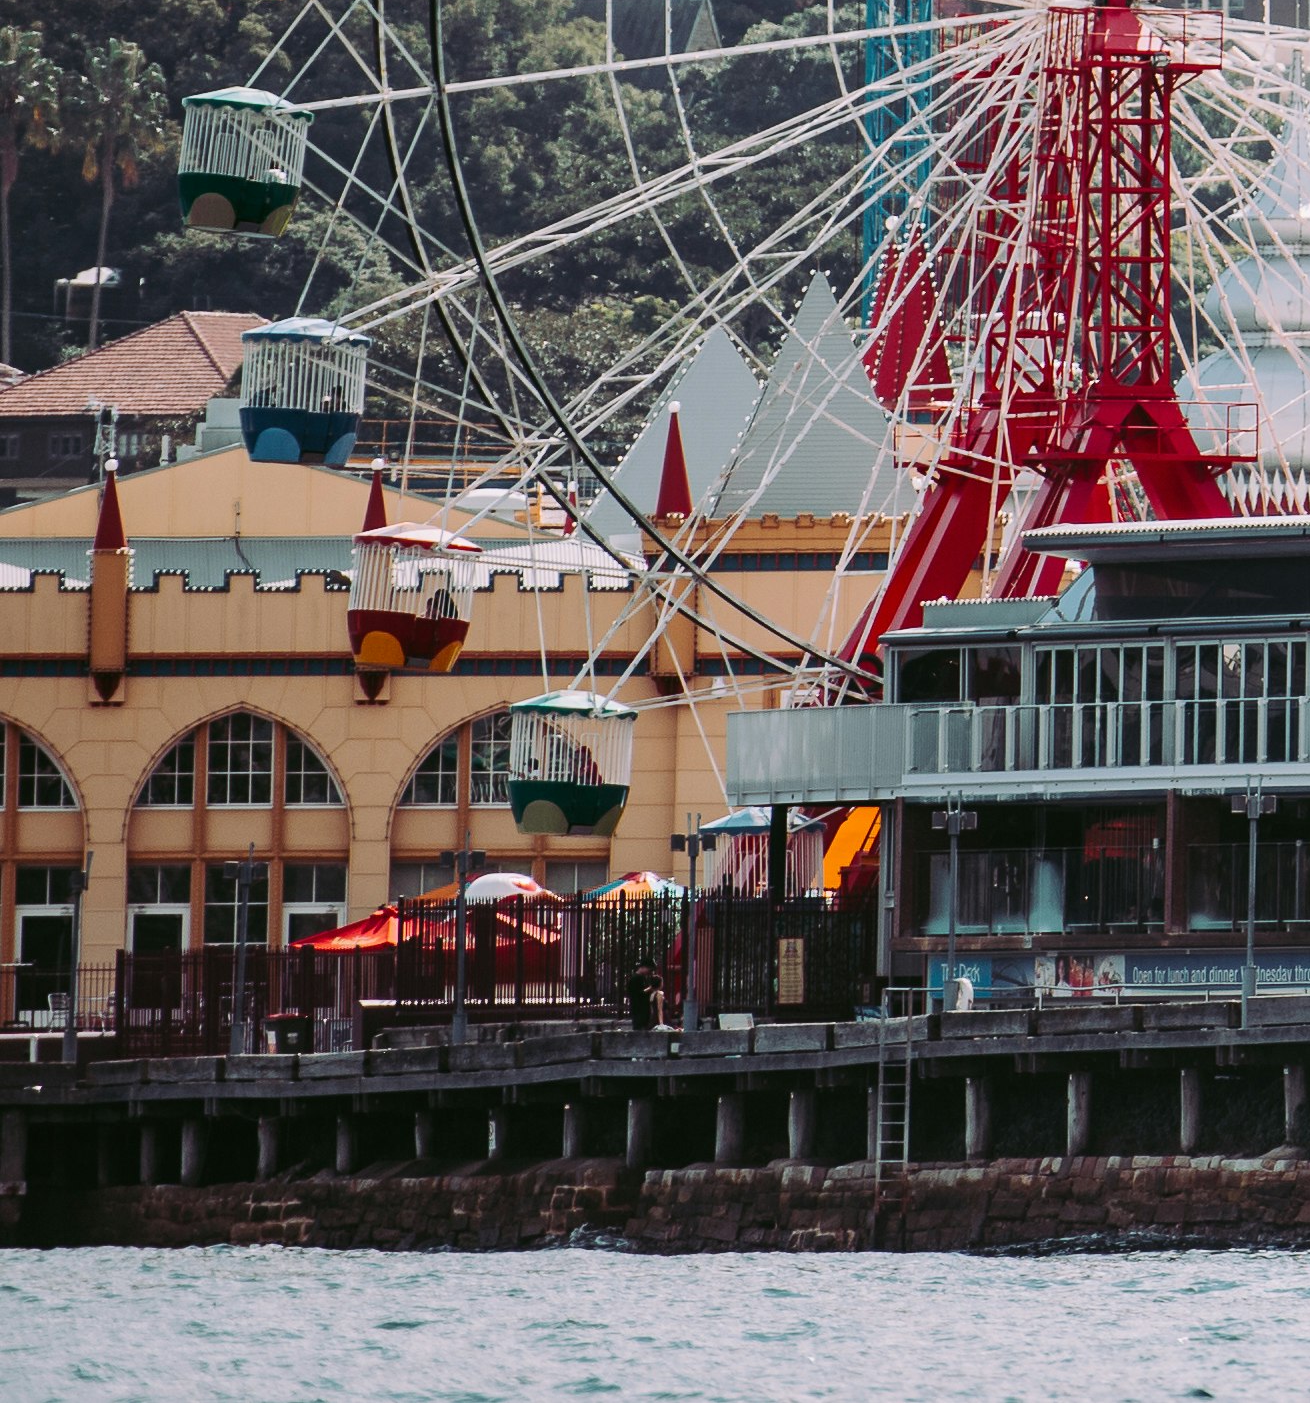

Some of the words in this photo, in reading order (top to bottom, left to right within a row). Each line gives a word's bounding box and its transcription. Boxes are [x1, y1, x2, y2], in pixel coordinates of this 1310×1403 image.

[1133, 966, 1153, 984] Open
[1155, 966, 1166, 984] for
[1167, 966, 1190, 984] lunch
[1191, 966, 1207, 983] and
[1209, 965, 1239, 983] dinner
[1241, 965, 1293, 983] dnesday
